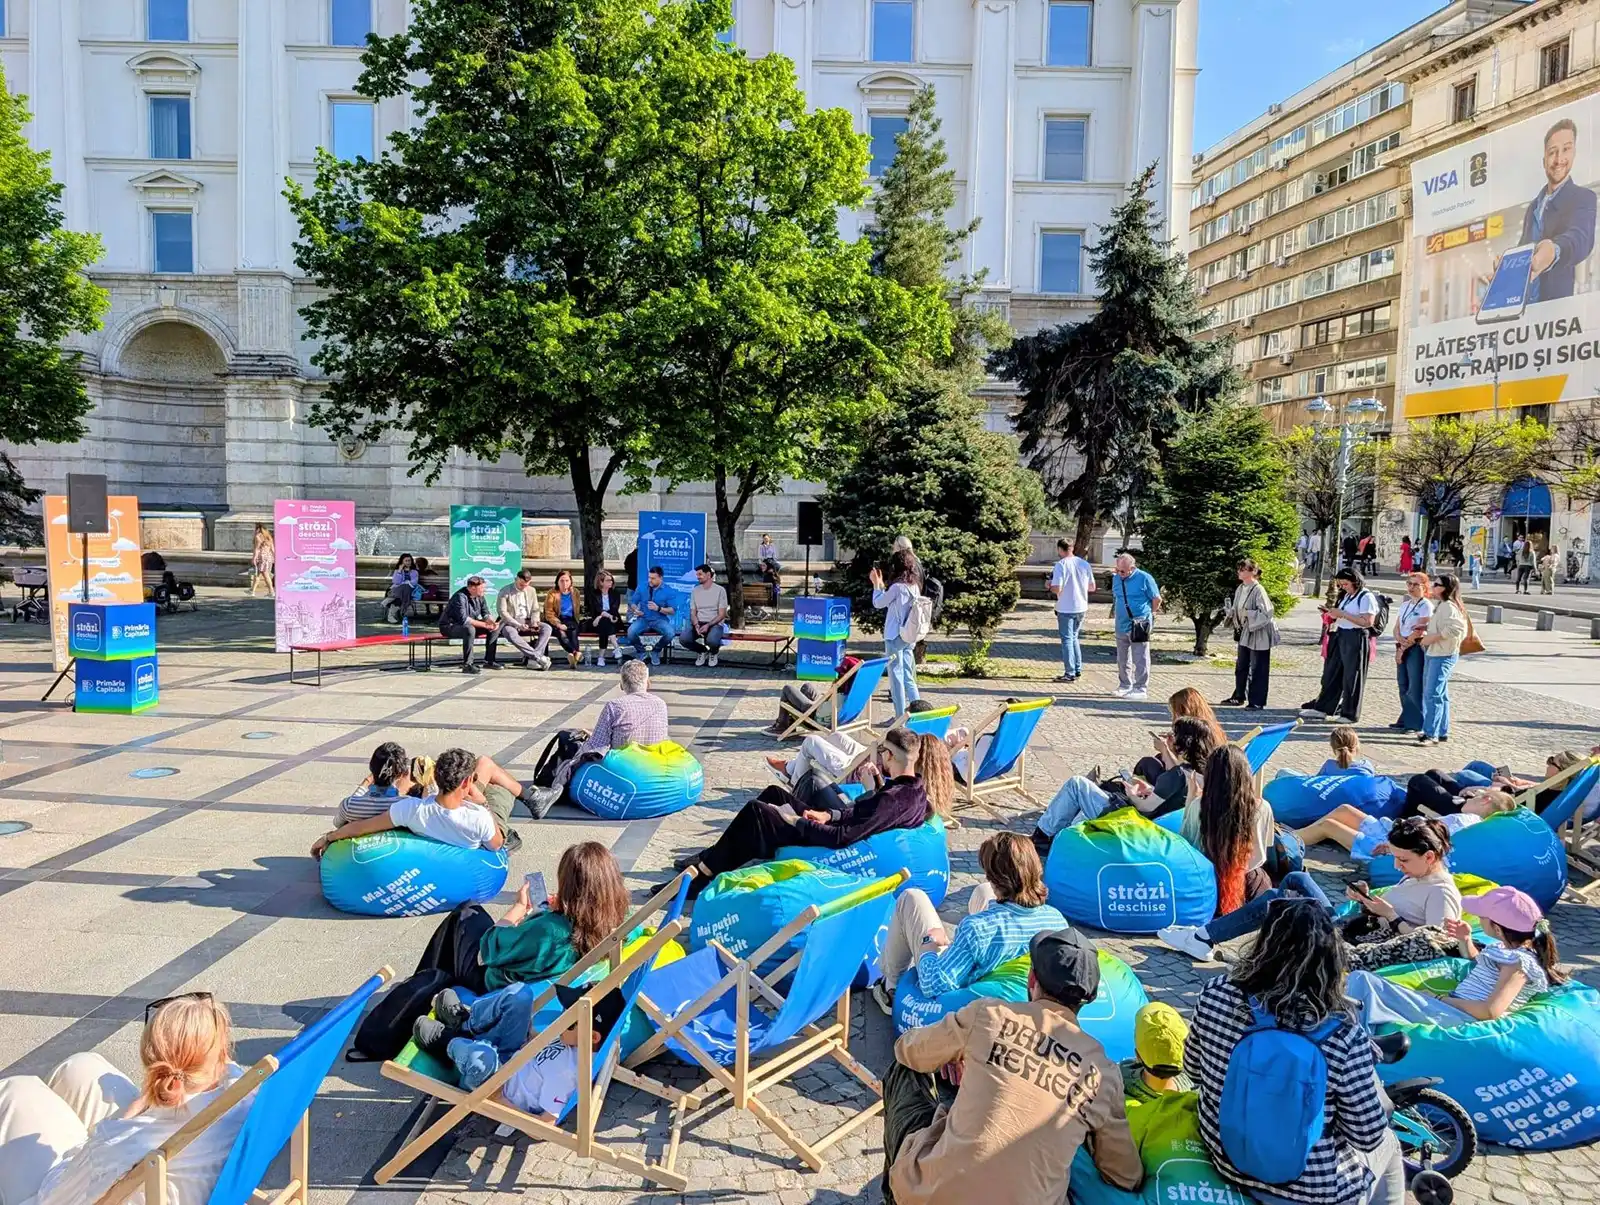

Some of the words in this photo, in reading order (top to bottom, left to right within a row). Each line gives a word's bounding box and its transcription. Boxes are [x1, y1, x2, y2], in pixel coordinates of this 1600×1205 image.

[1421, 169, 1458, 196] VISA
[1415, 330, 1499, 360] PLĂTEȘTE
[1503, 325, 1529, 346] CU
[1534, 316, 1582, 340] VISA
[1415, 362, 1466, 387] UȘOR,
[1470, 352, 1528, 376] RAPID
[1533, 348, 1552, 372] ȘI
[298, 521, 333, 531] străzi.
[653, 536, 691, 549] străzi.
[653, 548, 688, 557] deschise
[124, 623, 150, 632] Primăria
[124, 630, 150, 639] Capitalei
[583, 788, 620, 811] deschise
[586, 778, 626, 805] străzi.
[362, 886, 386, 903] Mai
[386, 867, 421, 893] puțin
[380, 884, 419, 905] trafic,
[1107, 881, 1170, 900] străzi.
[384, 899, 406, 915] mai
[406, 883, 437, 904] mult
[401, 896, 447, 917] hill.
[1108, 901, 1167, 912] deschise
[697, 922, 711, 938] Mai
[711, 912, 740, 936] puțin
[727, 939, 748, 954] ult
[911, 1000, 942, 1017] puțin
[997, 1018, 1082, 1078] PAUSE
[1084, 1064, 1099, 1097] &
[986, 1041, 1094, 1118] REFLECT
[1474, 1067, 1548, 1102] Strada
[1473, 1112, 1489, 1123] e
[1490, 1088, 1542, 1119] noul
[1540, 1072, 1578, 1098] tău
[1498, 1105, 1600, 1148] elaxare.
[1503, 1112, 1542, 1132] loc
[1543, 1100, 1571, 1118] de
[1167, 1180, 1239, 1205] străzi.
